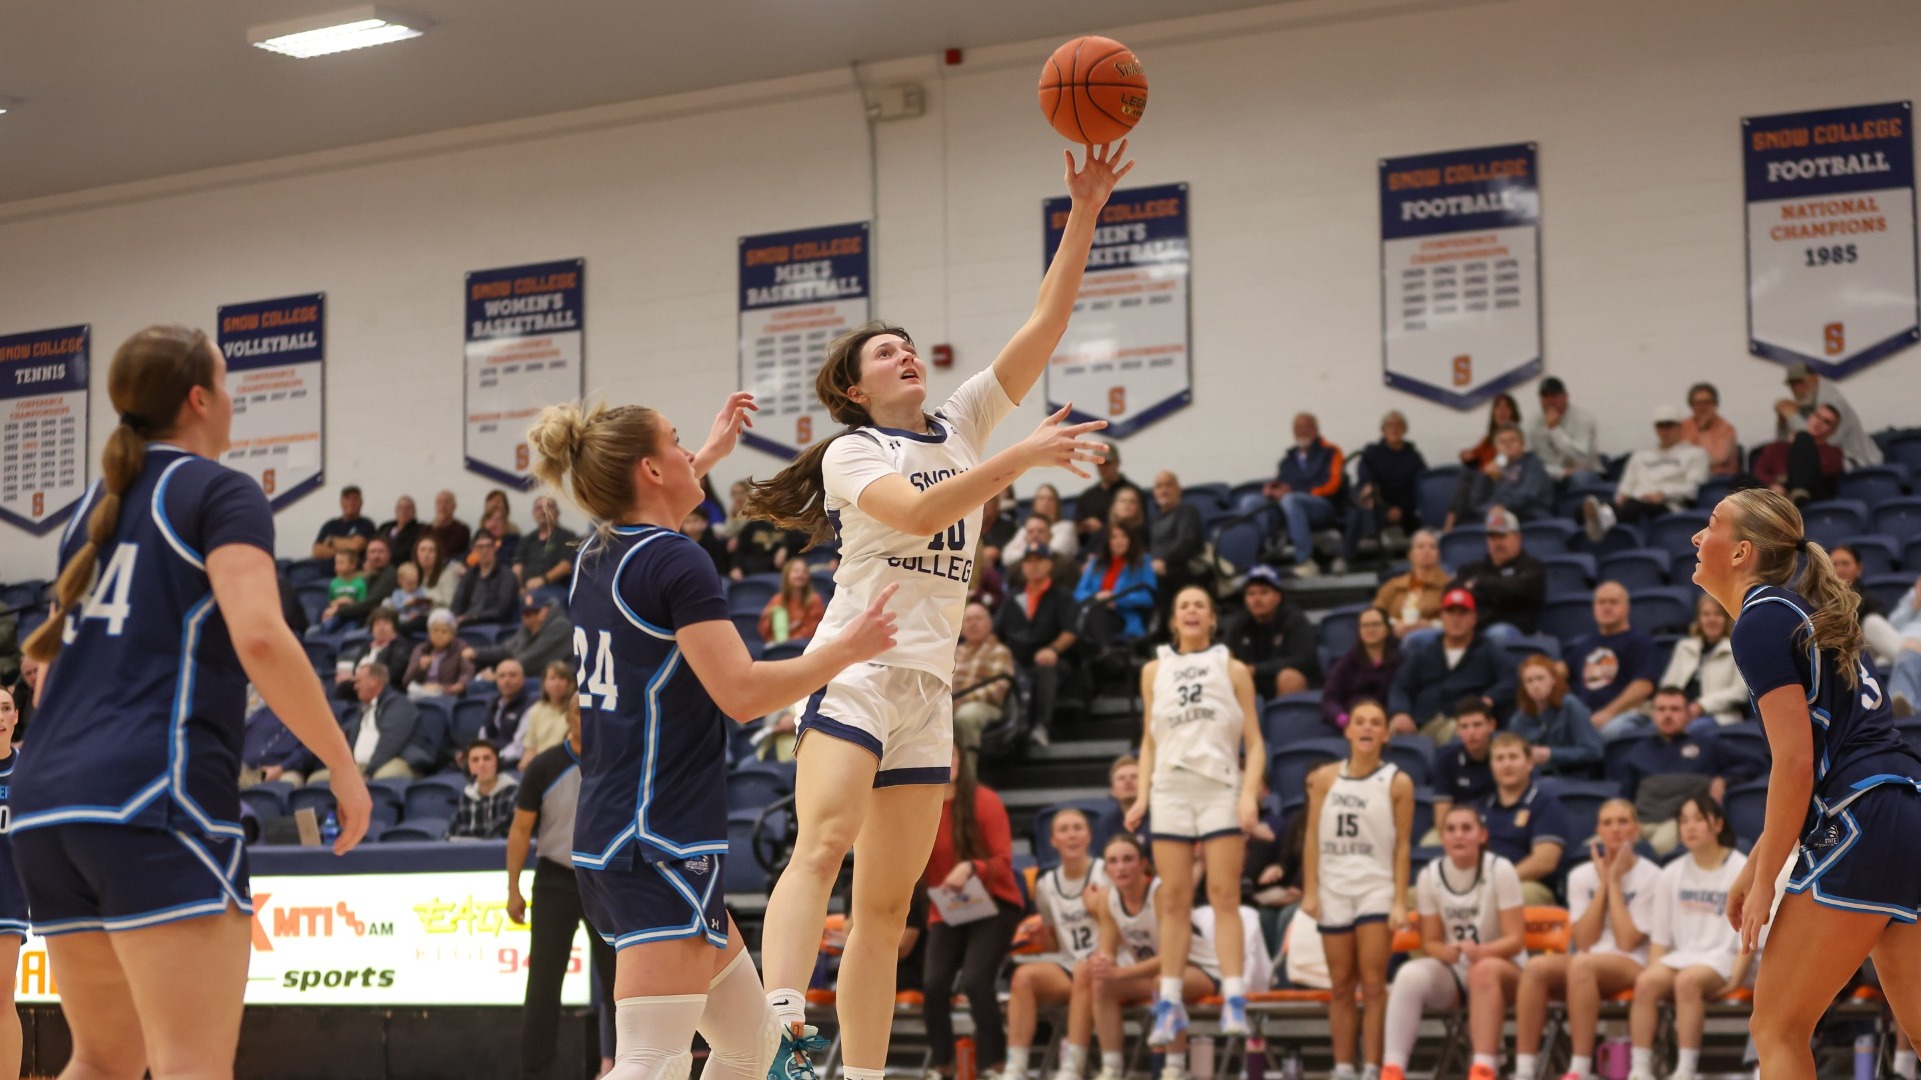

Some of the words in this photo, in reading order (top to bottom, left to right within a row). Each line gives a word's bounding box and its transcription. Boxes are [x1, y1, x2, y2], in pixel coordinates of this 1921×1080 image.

[1752, 127, 1810, 151] SNOW
[1813, 117, 1903, 145] COLLEGE
[1388, 168, 1441, 192] SNOW
[1444, 158, 1527, 185] COLLEGE
[1767, 151, 1891, 182] FOOTBALL
[1103, 198, 1179, 223] COLLEGE
[1401, 188, 1515, 222] FOOTBALL
[1781, 197, 1880, 220] NATIONAL
[1769, 217, 1888, 241] CHAMPIONS
[746, 246, 789, 267] SNOW
[792, 236, 862, 260] COLLEGE
[1804, 244, 1859, 267] 1985
[775, 259, 832, 284] MEN'S
[472, 281, 511, 300] SNOW
[514, 272, 576, 294] COLLEGE
[746, 276, 863, 306] BASKETBALL
[484, 292, 563, 317] WOMEN'S
[223, 313, 259, 333] SNOW
[261, 305, 318, 328] COLLEGE
[472, 310, 576, 338] BASKETBALL
[0, 344, 31, 362] SNOW
[32, 336, 84, 358] COLLEGE
[223, 331, 318, 358] VOLLEYBALL
[1823, 322, 1845, 356] S
[15, 363, 66, 385] TENNIS
[1452, 354, 1472, 387] S
[1108, 386, 1126, 416] S
[796, 416, 812, 444] S
[887, 554, 973, 583] COLLEG
[573, 626, 618, 712] 24
[1173, 666, 1209, 682] SNOW
[1177, 683, 1203, 707] 32
[1168, 707, 1216, 729] COLLEGE
[1331, 792, 1369, 809] SNOW
[1336, 813, 1359, 837] 15
[1323, 841, 1375, 858] COLLEGE
[368, 922, 394, 936] AM
[1071, 927, 1092, 951] 12
[282, 966, 396, 992] sports
